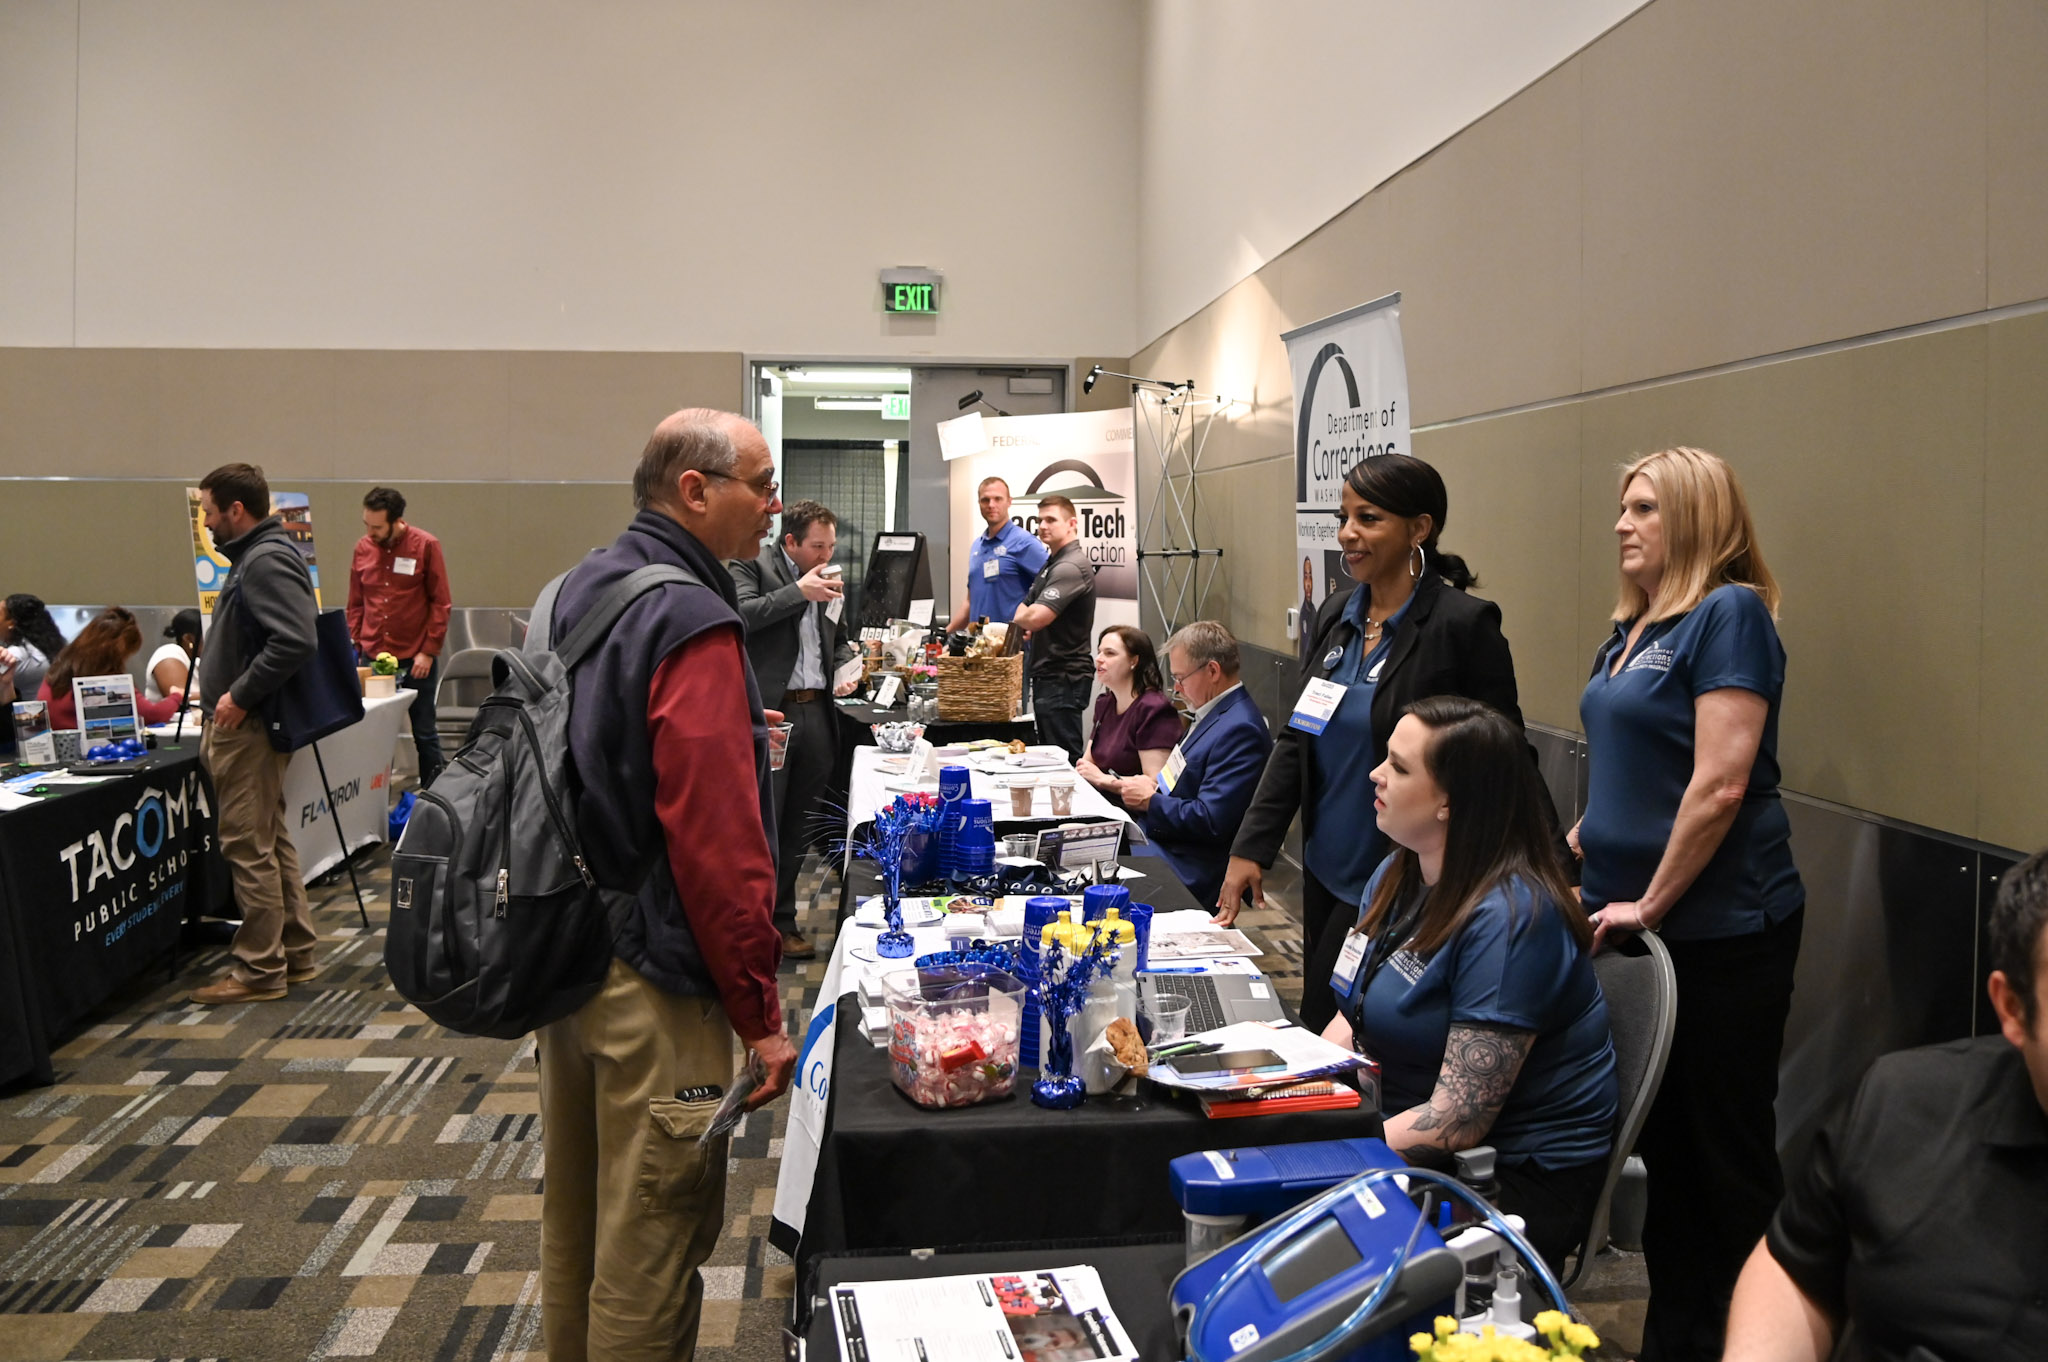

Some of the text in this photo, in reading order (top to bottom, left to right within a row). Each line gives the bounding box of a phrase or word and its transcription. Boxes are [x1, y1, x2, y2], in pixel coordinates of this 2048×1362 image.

[894, 285, 932, 311] EXIT
[890, 397, 908, 417] EXI
[1328, 401, 1396, 439] Department of
[1105, 428, 1133, 441] COMME
[1314, 488, 1342, 502] WASHIN
[1081, 508, 1125, 539] Tech
[59, 771, 212, 903] TACOMA
[74, 834, 211, 942] PUBLIC SCHOS
[105, 923, 128, 947] EVERY
[810, 1061, 829, 1101] Co
